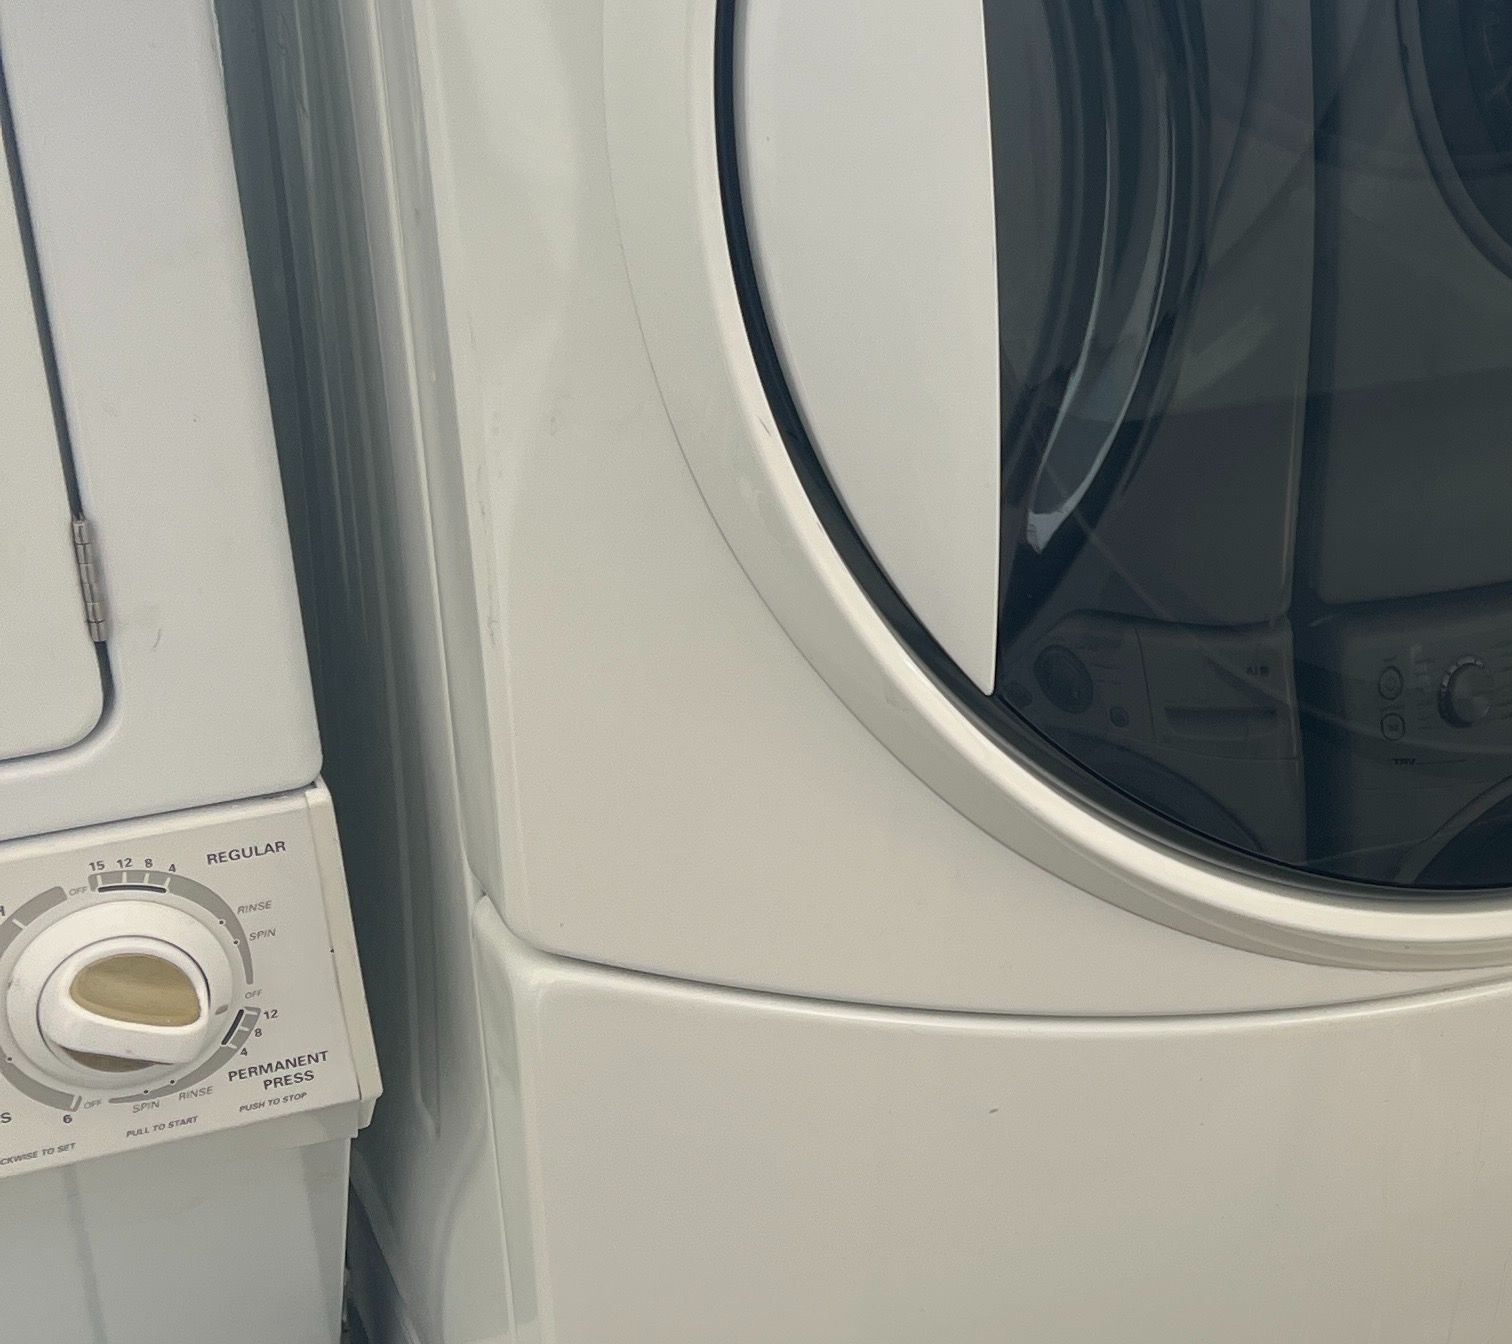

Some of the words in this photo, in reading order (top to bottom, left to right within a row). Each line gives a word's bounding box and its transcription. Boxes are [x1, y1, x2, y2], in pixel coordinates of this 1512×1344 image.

[206, 840, 286, 865] REGULAR
[89, 861, 105, 871] 15
[116, 858, 132, 869] 12
[145, 859, 153, 868] 8
[168, 864, 176, 872] 4
[69, 886, 88, 896] OFF
[237, 900, 272, 914] RINSE
[249, 928, 276, 941] SPIN
[245, 989, 262, 999] OFF
[264, 1009, 278, 1019] 12
[255, 1028, 262, 1037] 8
[240, 1048, 248, 1056] 4
[228, 1050, 328, 1082] PERMANENT
[263, 1070, 315, 1090] PRESS
[132, 1100, 160, 1113] SPIN
[178, 1086, 214, 1101] RINSE
[239, 1100, 265, 1113] PUSH
[283, 1092, 307, 1103] STOP
[63, 1114, 72, 1124] 6
[126, 1127, 150, 1138] PULL
[153, 1124, 166, 1132] TO
[168, 1116, 199, 1129] START
[42, 1147, 55, 1156] TO
[57, 1143, 76, 1153] SET
